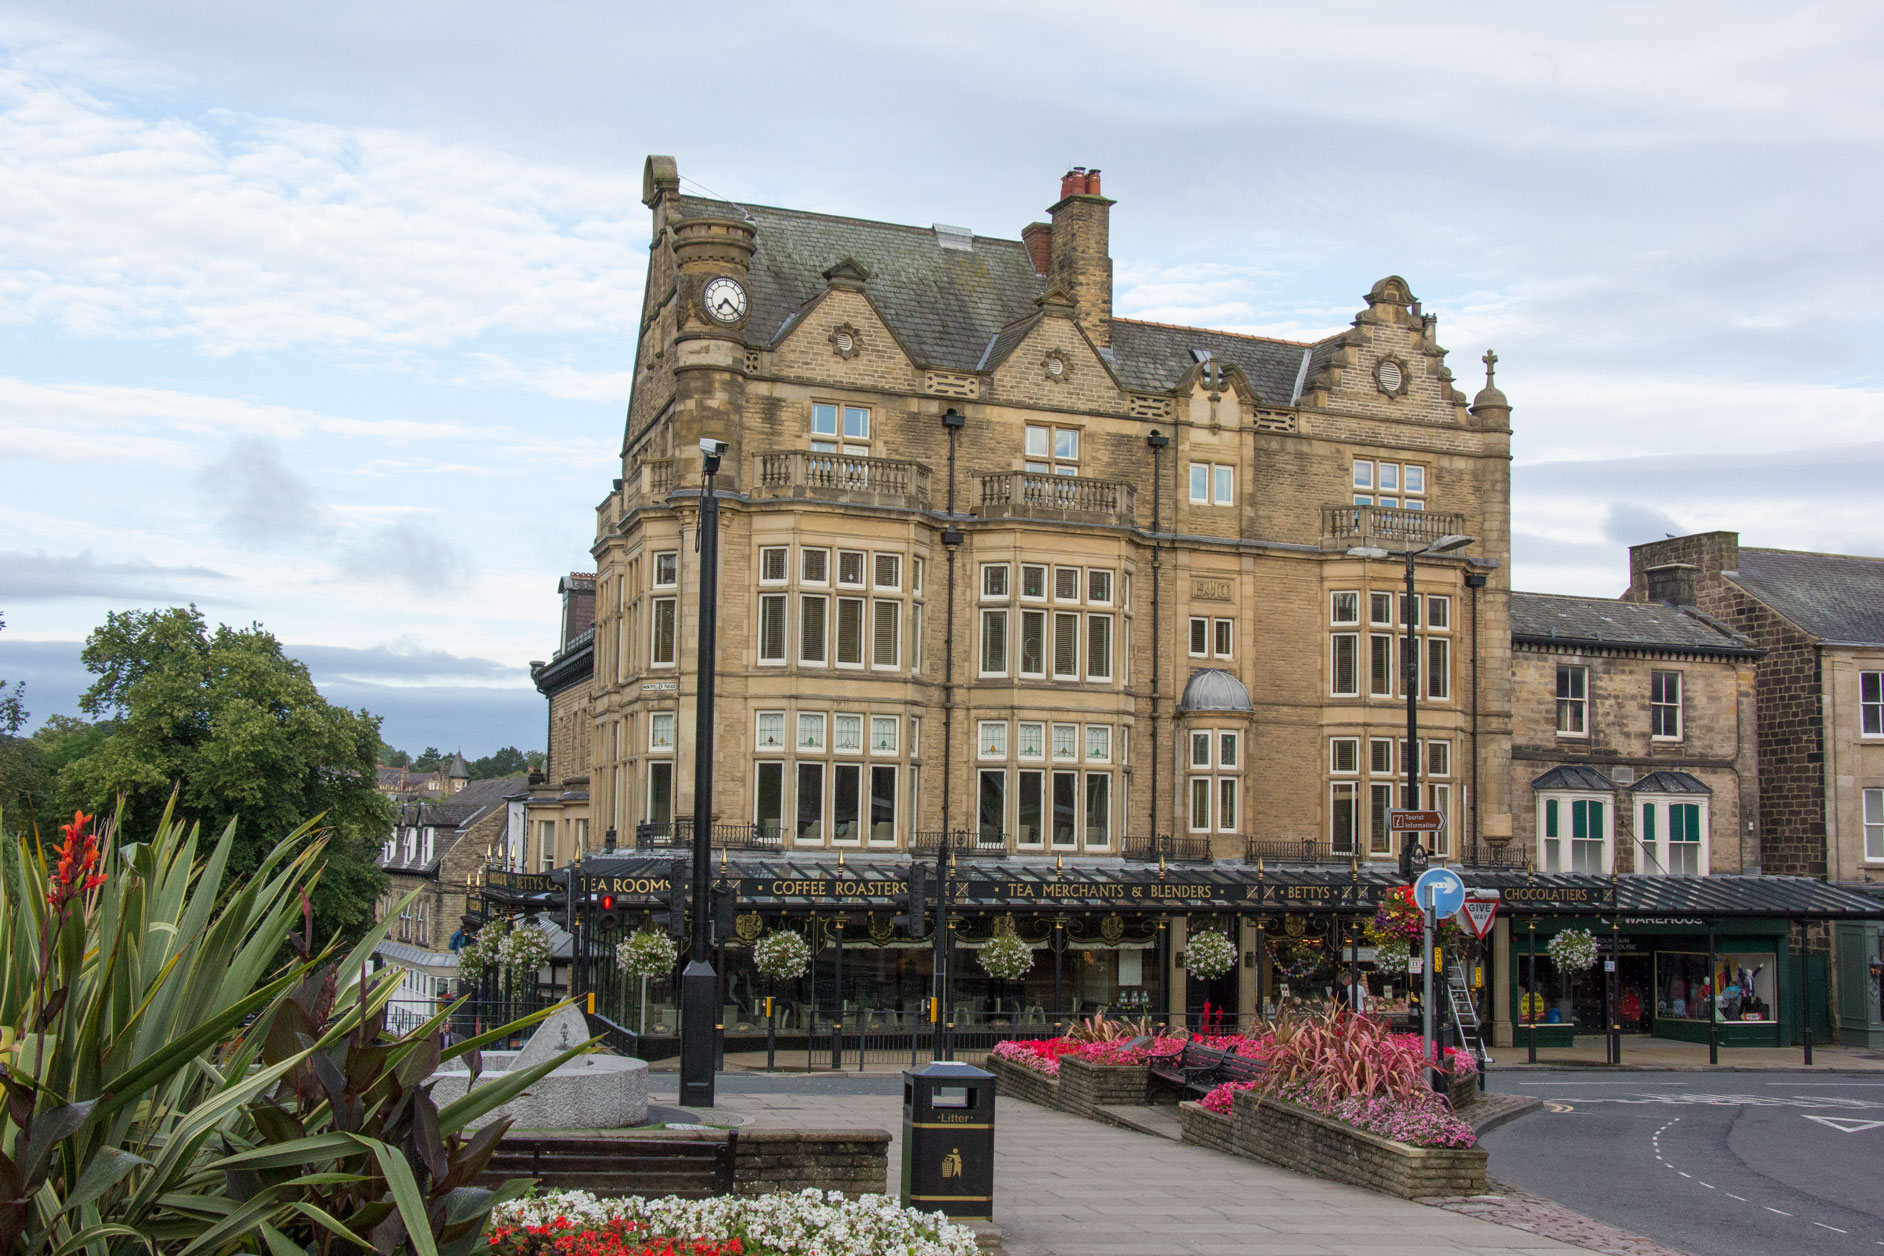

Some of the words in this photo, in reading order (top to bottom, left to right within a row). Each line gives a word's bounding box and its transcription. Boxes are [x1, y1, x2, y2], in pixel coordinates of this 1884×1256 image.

[516, 875, 543, 890] BETTYS
[581, 877, 607, 892] TEA
[613, 878, 671, 894] ROOMS
[772, 880, 826, 895] COFFEE
[835, 881, 908, 896] ROASTERS
[1008, 883, 1034, 897] TEA
[1042, 883, 1124, 898] MERCHANTS
[1131, 886, 1143, 898] &
[1151, 884, 1212, 899] BLENDERS
[1288, 886, 1330, 899] BETTYS
[1504, 888, 1587, 901] CHOCOLATIERS
[1468, 903, 1491, 913] GIVE
[1625, 916, 1706, 925] WAREHOUS
[941, 1113, 970, 1123] Litter
